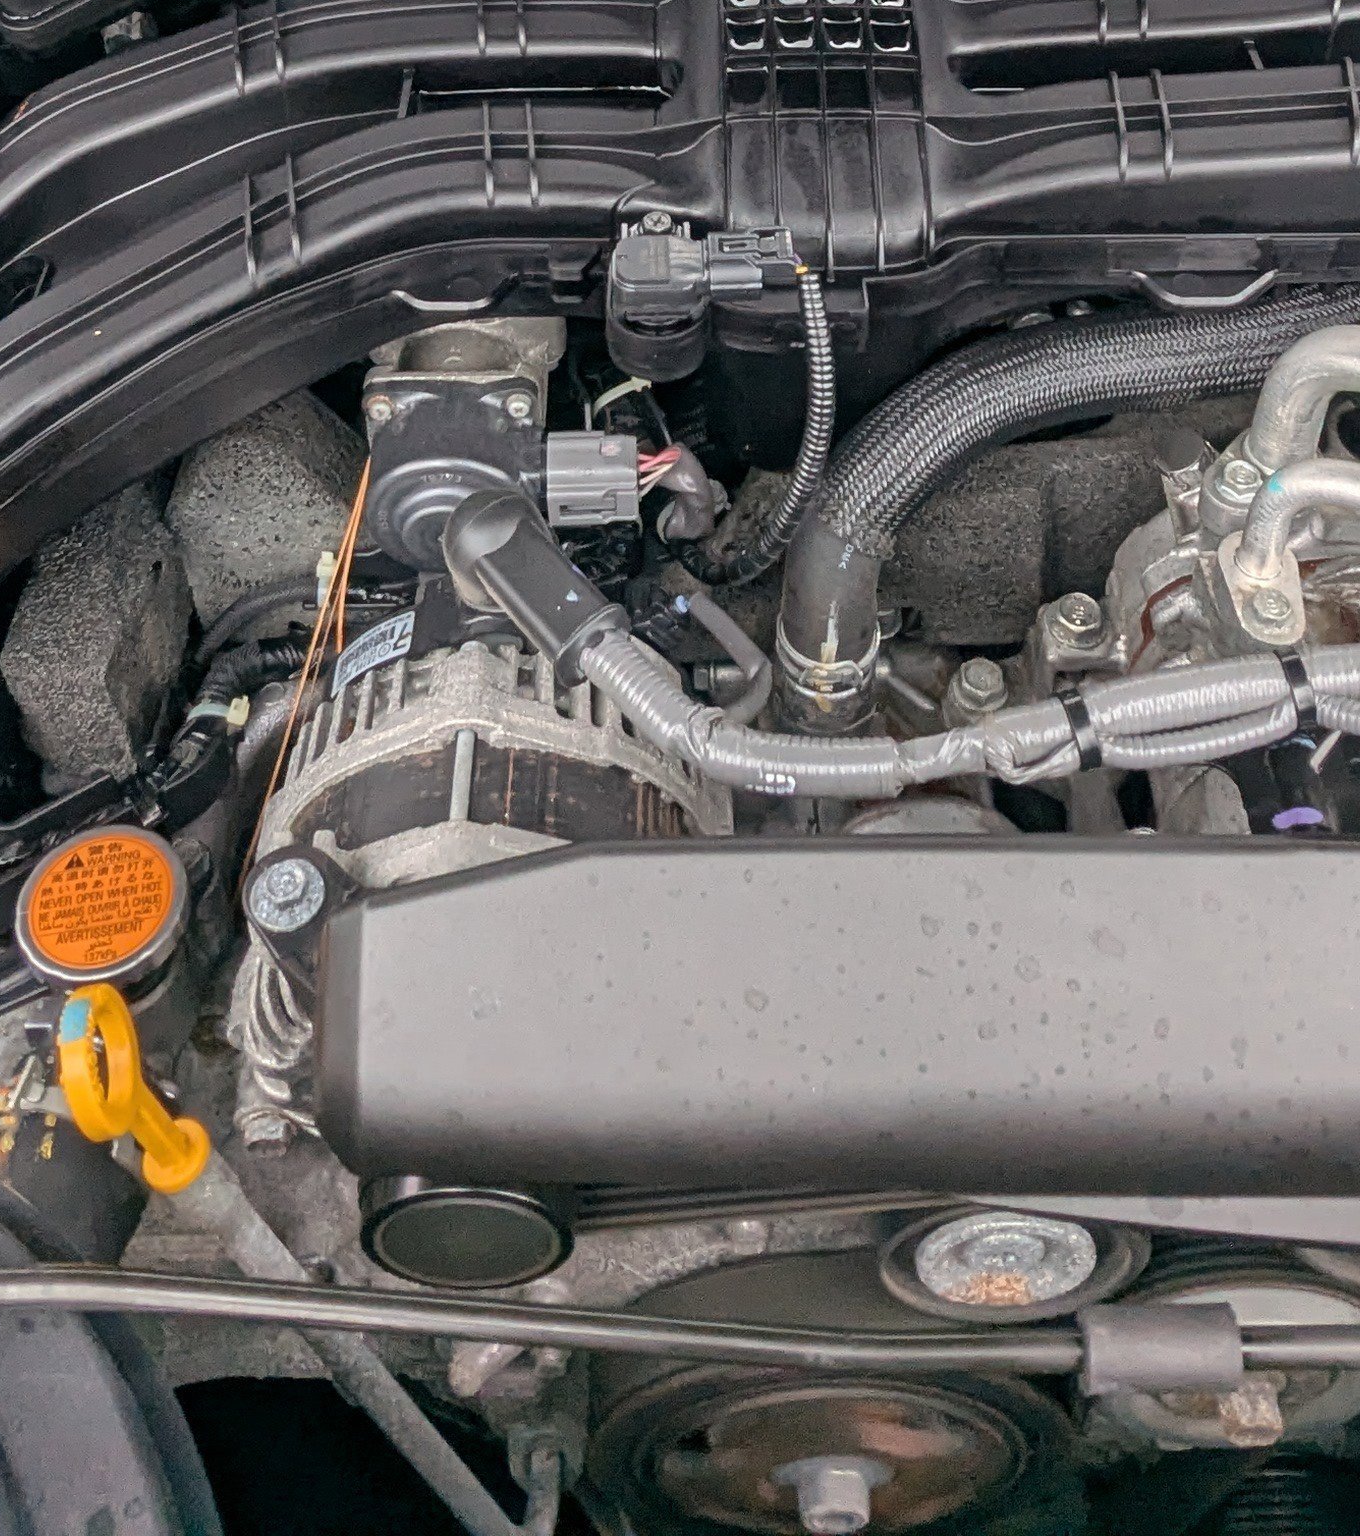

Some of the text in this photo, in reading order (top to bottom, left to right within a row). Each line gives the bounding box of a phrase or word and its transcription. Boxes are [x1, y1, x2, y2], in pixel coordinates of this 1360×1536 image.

[87, 850, 140, 866] WARNING
[39, 895, 73, 910] NEVER
[76, 890, 103, 903] OPEN
[107, 885, 137, 899] WHEN
[52, 907, 85, 920] JAMAIS
[87, 901, 120, 915] OUVRIR
[55, 920, 144, 946] AVERTISSEMENT
